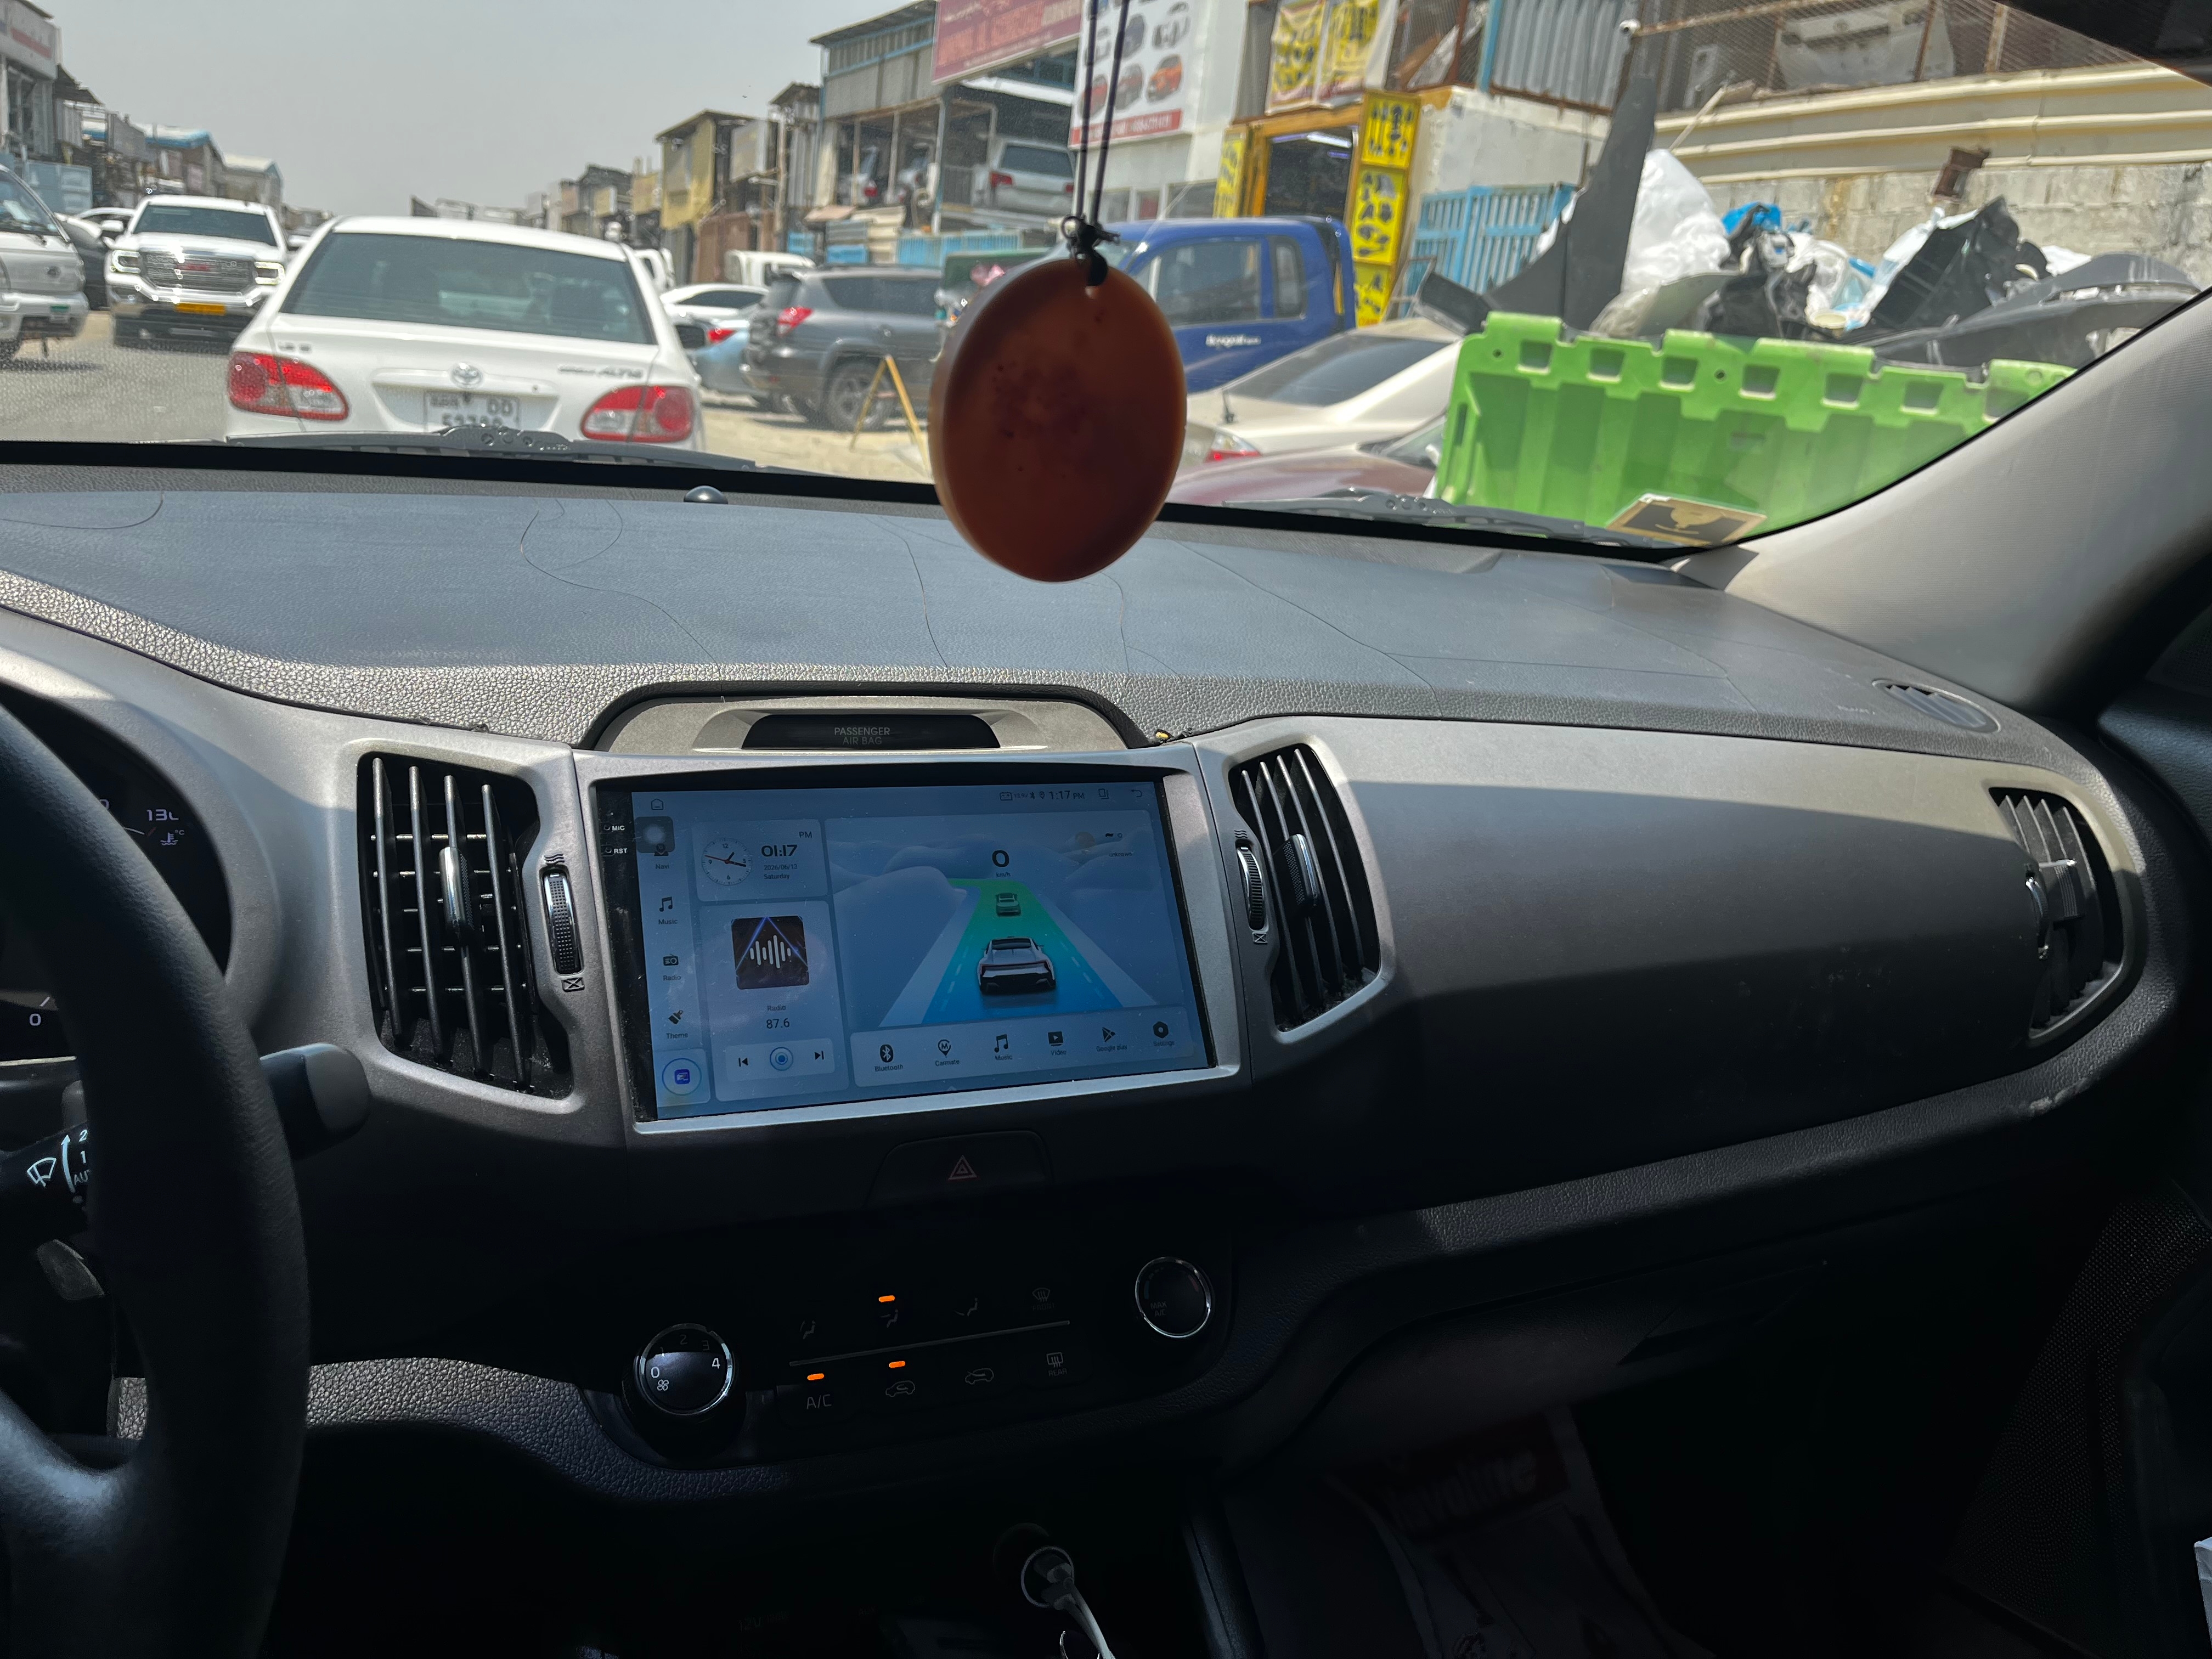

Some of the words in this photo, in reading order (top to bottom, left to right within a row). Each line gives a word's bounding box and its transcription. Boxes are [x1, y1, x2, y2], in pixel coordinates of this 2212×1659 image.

[834, 727, 890, 736] PASSENGER
[842, 737, 859, 746] AIR
[862, 736, 883, 745] BAG
[1048, 790, 1070, 800] 1:17
[761, 844, 798, 857] 01:17
[766, 1018, 790, 1029] 87.6
[78, 1129, 88, 1142] 2
[80, 1150, 87, 1164] 1
[74, 1170, 90, 1187] AU
[1150, 1301, 1168, 1310] MAX
[711, 1358, 721, 1369] 4
[651, 1367, 661, 1379] 0
[1048, 1367, 1068, 1378] REAR
[806, 1393, 832, 1410] A/C
